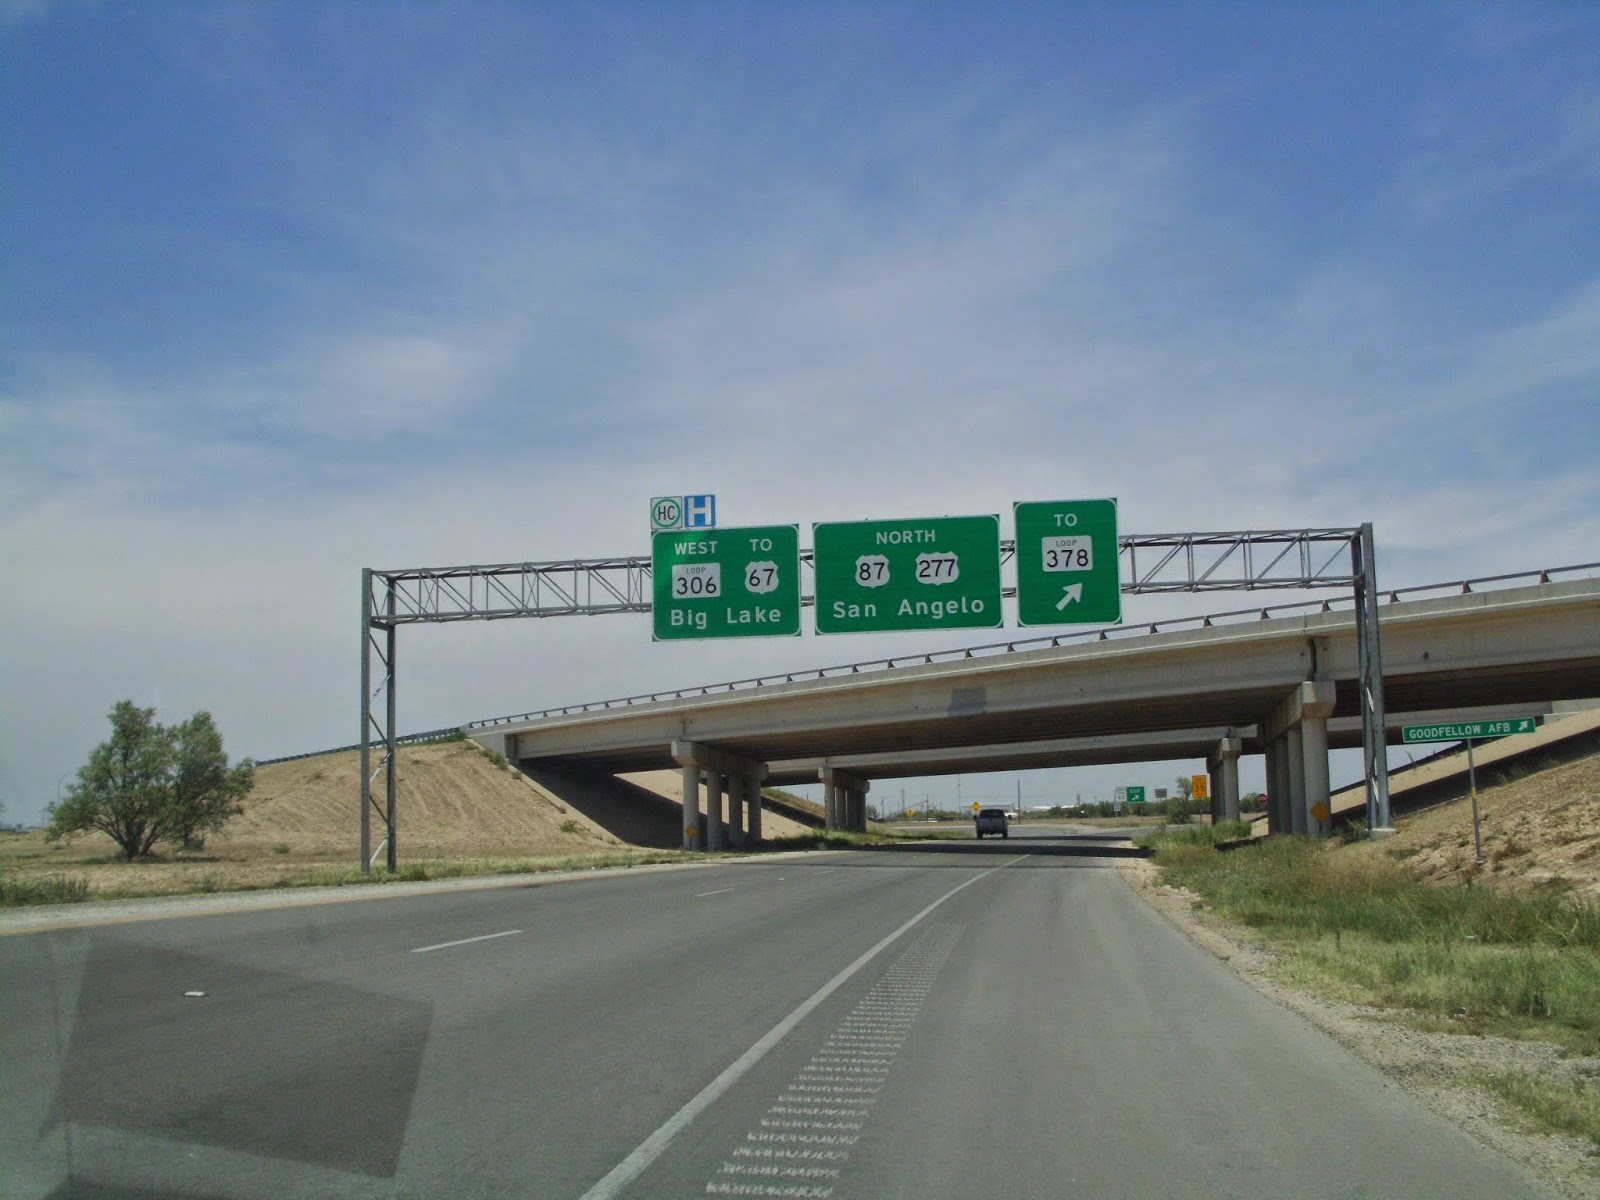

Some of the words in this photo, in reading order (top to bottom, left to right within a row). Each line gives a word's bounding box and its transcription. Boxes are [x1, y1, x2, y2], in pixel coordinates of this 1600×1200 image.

[658, 505, 675, 520] HC
[688, 496, 711, 526] H
[1054, 513, 1077, 526] TO
[750, 539, 772, 551] TO
[876, 529, 936, 544] NORTH
[1056, 539, 1077, 547] LOOP
[675, 541, 718, 555] WEST
[1046, 549, 1088, 568] 378
[686, 567, 706, 575] LOOP
[859, 562, 885, 580] 87
[918, 559, 955, 578] 277
[676, 576, 717, 595] 306
[748, 568, 774, 587] 67
[833, 601, 877, 618] San
[898, 596, 984, 619] Angelo
[671, 609, 707, 630] Big
[727, 606, 781, 624] Lake
[1409, 724, 1481, 739] GOODFELLOW
[1488, 722, 1510, 733] AFB
